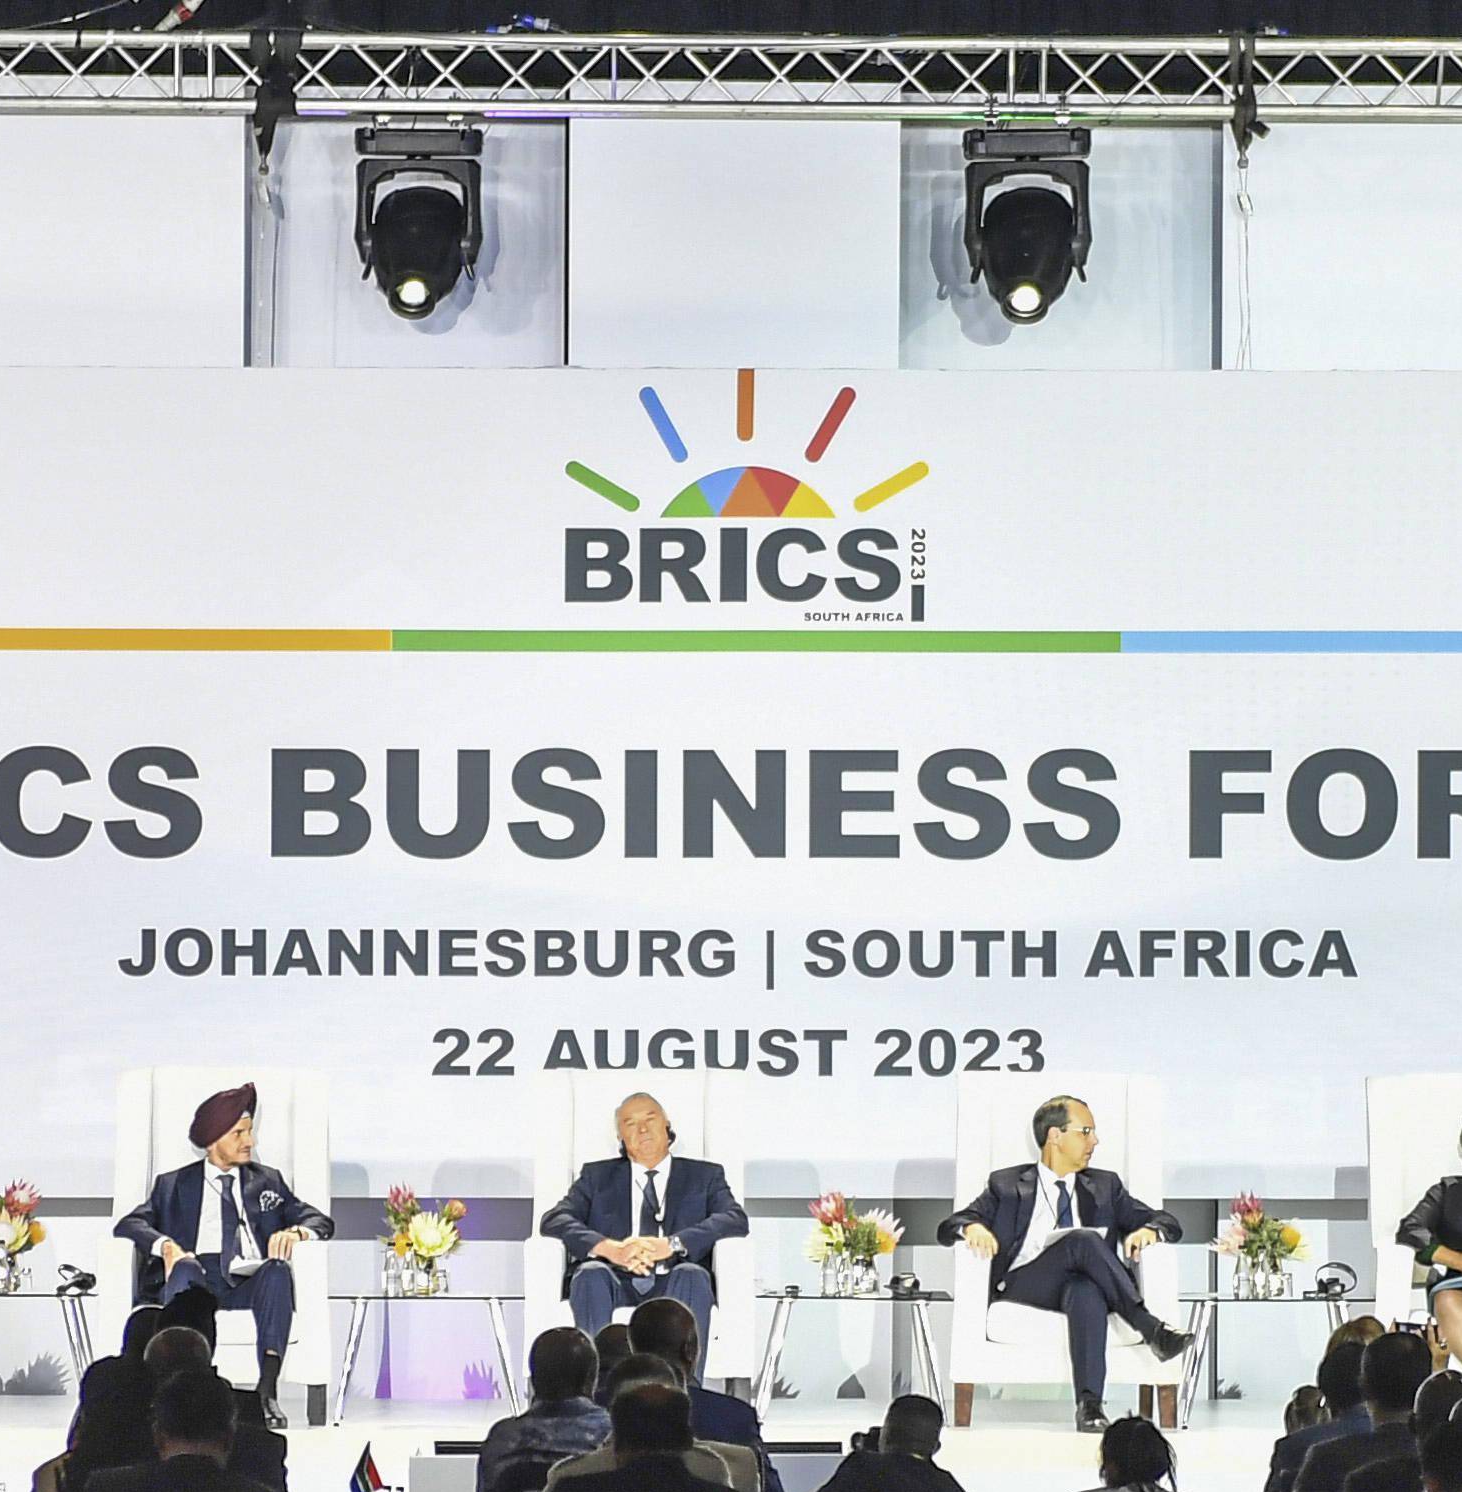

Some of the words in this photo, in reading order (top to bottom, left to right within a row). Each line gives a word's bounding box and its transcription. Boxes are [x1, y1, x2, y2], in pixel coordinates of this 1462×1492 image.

[564, 527, 902, 603] BRICS
[910, 528, 926, 580] 2023
[804, 612, 850, 622] SOUTH
[855, 612, 904, 622] AFRICA
[270, 747, 1122, 861] BUSINESS
[118, 928, 736, 978] JOHANNESBURG
[804, 929, 1057, 979] SOUTH
[1084, 929, 1358, 978] AFRICA
[431, 1028, 515, 1076] 22
[543, 1028, 848, 1077] AUGUST
[874, 1028, 1046, 1077] 2023
